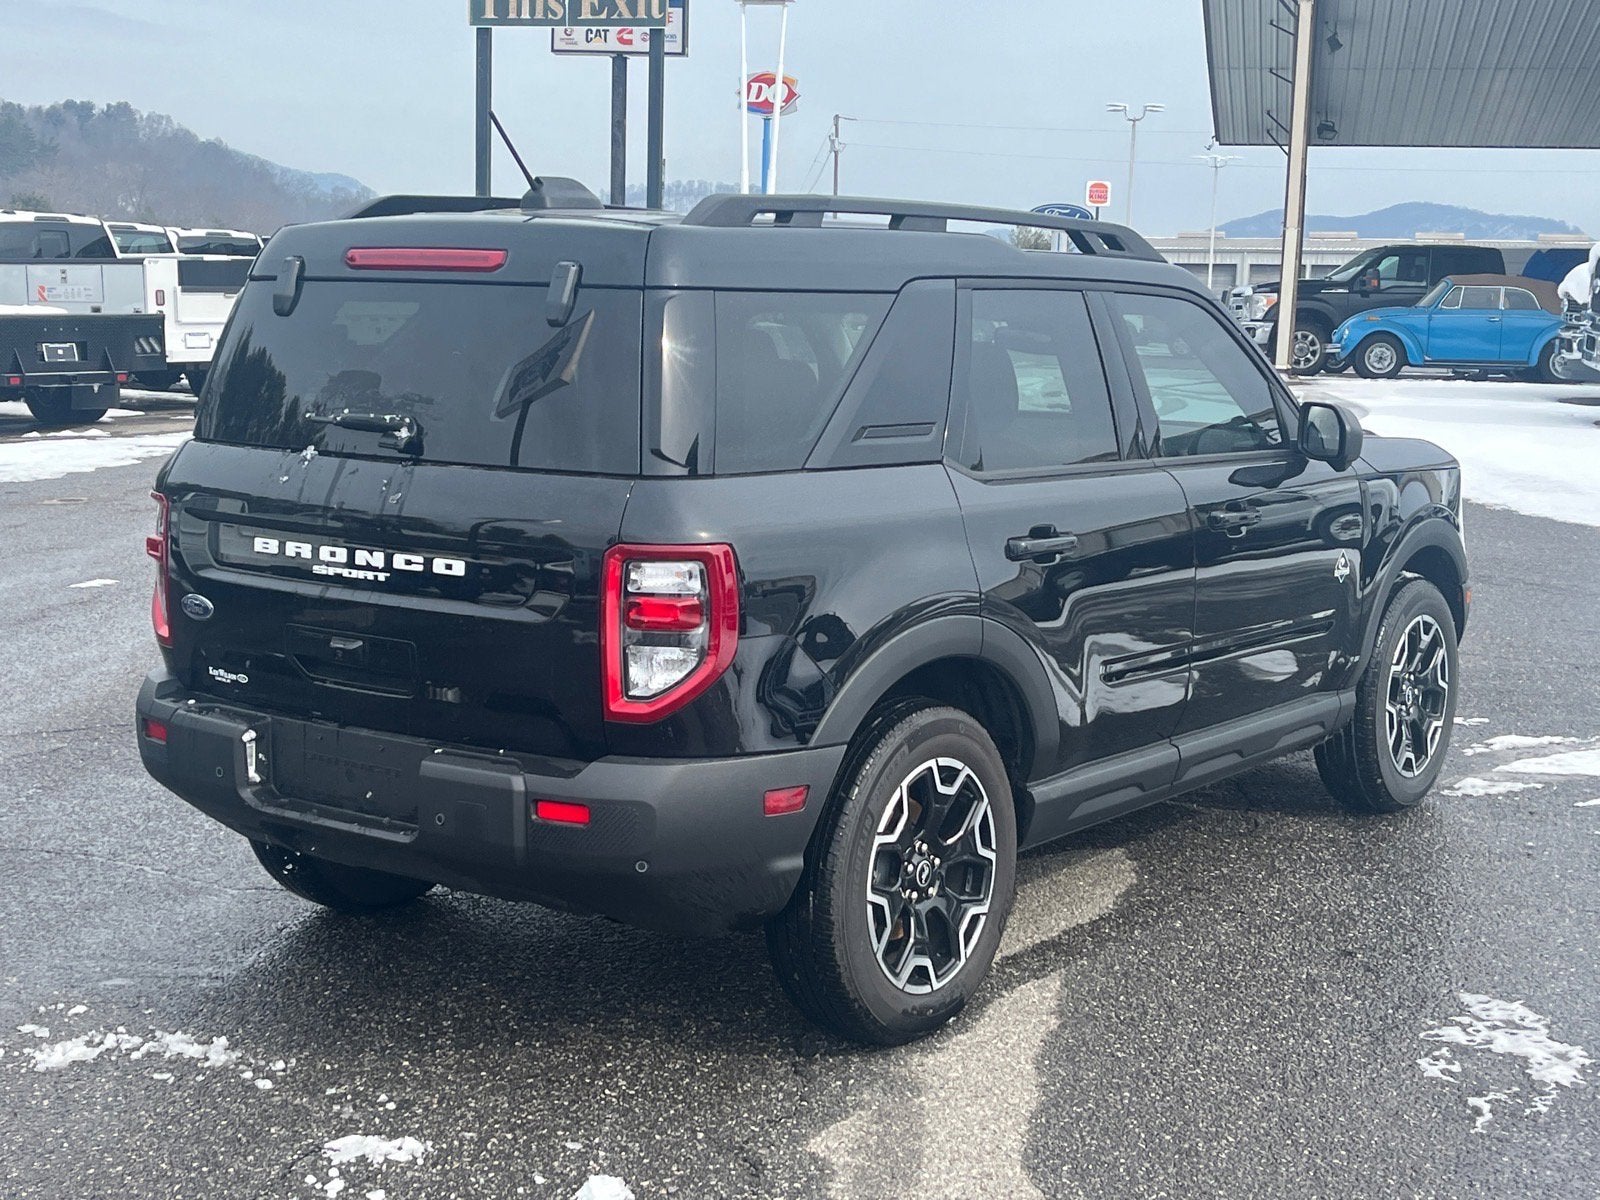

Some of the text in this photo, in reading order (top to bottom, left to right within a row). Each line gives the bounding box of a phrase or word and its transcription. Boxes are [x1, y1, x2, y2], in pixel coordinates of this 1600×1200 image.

[577, 0, 664, 19] Exit
[585, 28, 610, 43] CAT
[253, 536, 467, 577] BRONCO
[312, 564, 391, 582] SPORT
